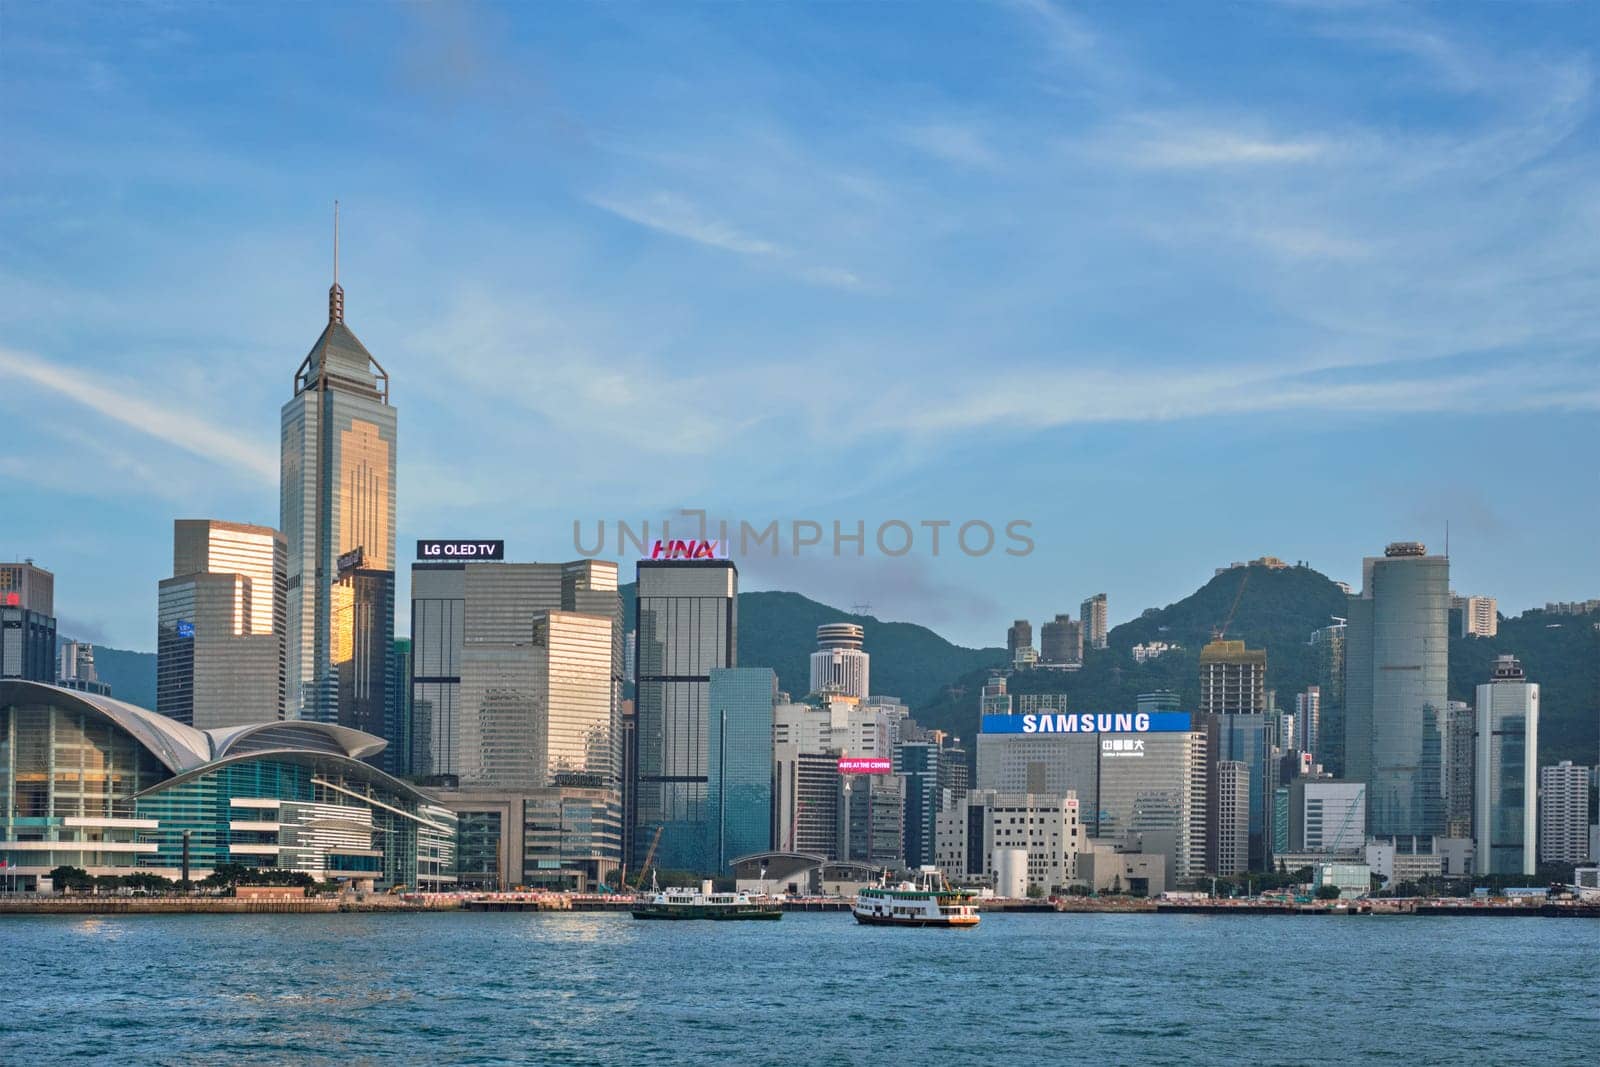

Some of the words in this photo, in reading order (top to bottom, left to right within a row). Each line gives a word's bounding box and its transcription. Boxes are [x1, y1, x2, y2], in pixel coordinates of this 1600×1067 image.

[424, 544, 441, 555] LG
[444, 544, 476, 555] OLED
[478, 544, 495, 555] TV
[651, 540, 718, 559] HNA
[1022, 713, 1150, 733] SAMSUNG
